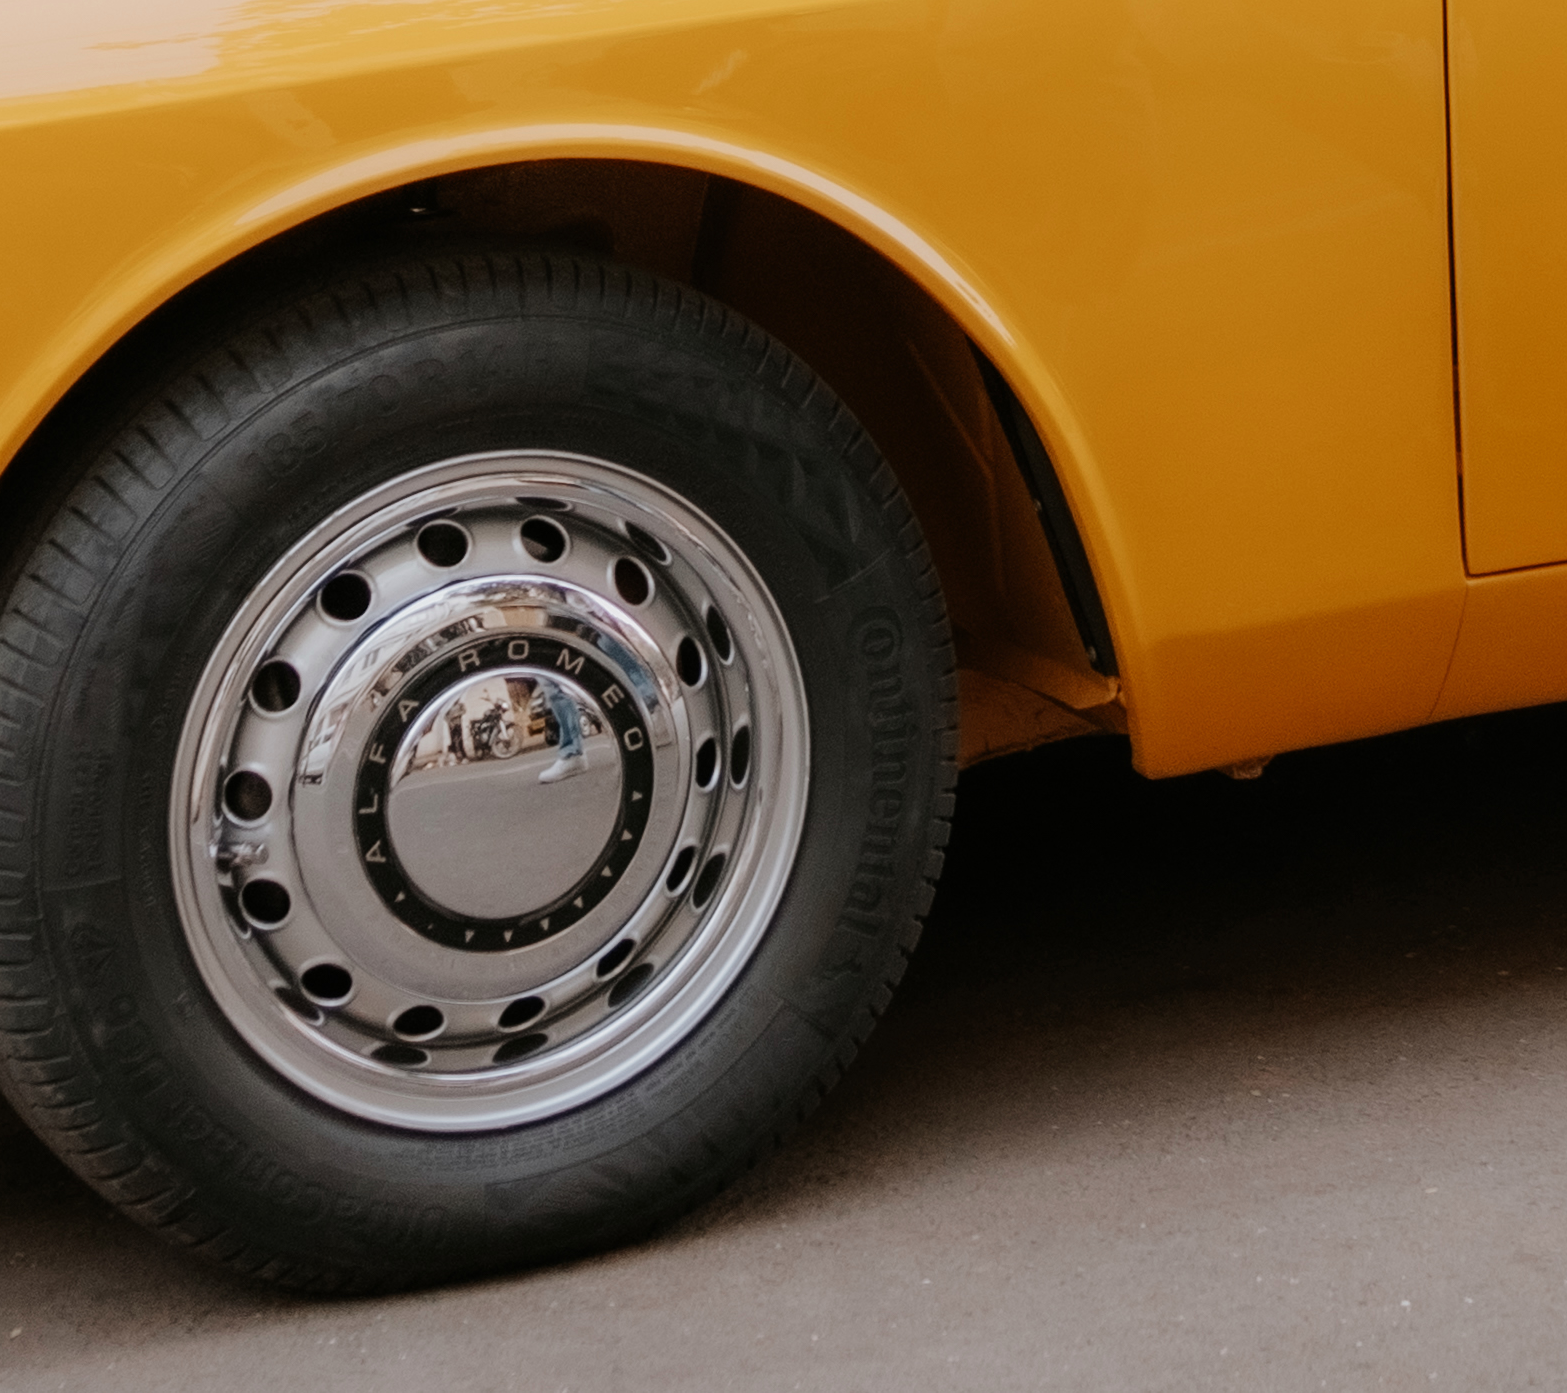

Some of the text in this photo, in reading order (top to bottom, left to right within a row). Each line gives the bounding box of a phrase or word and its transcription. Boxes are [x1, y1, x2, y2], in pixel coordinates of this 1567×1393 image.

[358, 639, 644, 864] ALFA ROMEO
[834, 605, 914, 938] Continental
